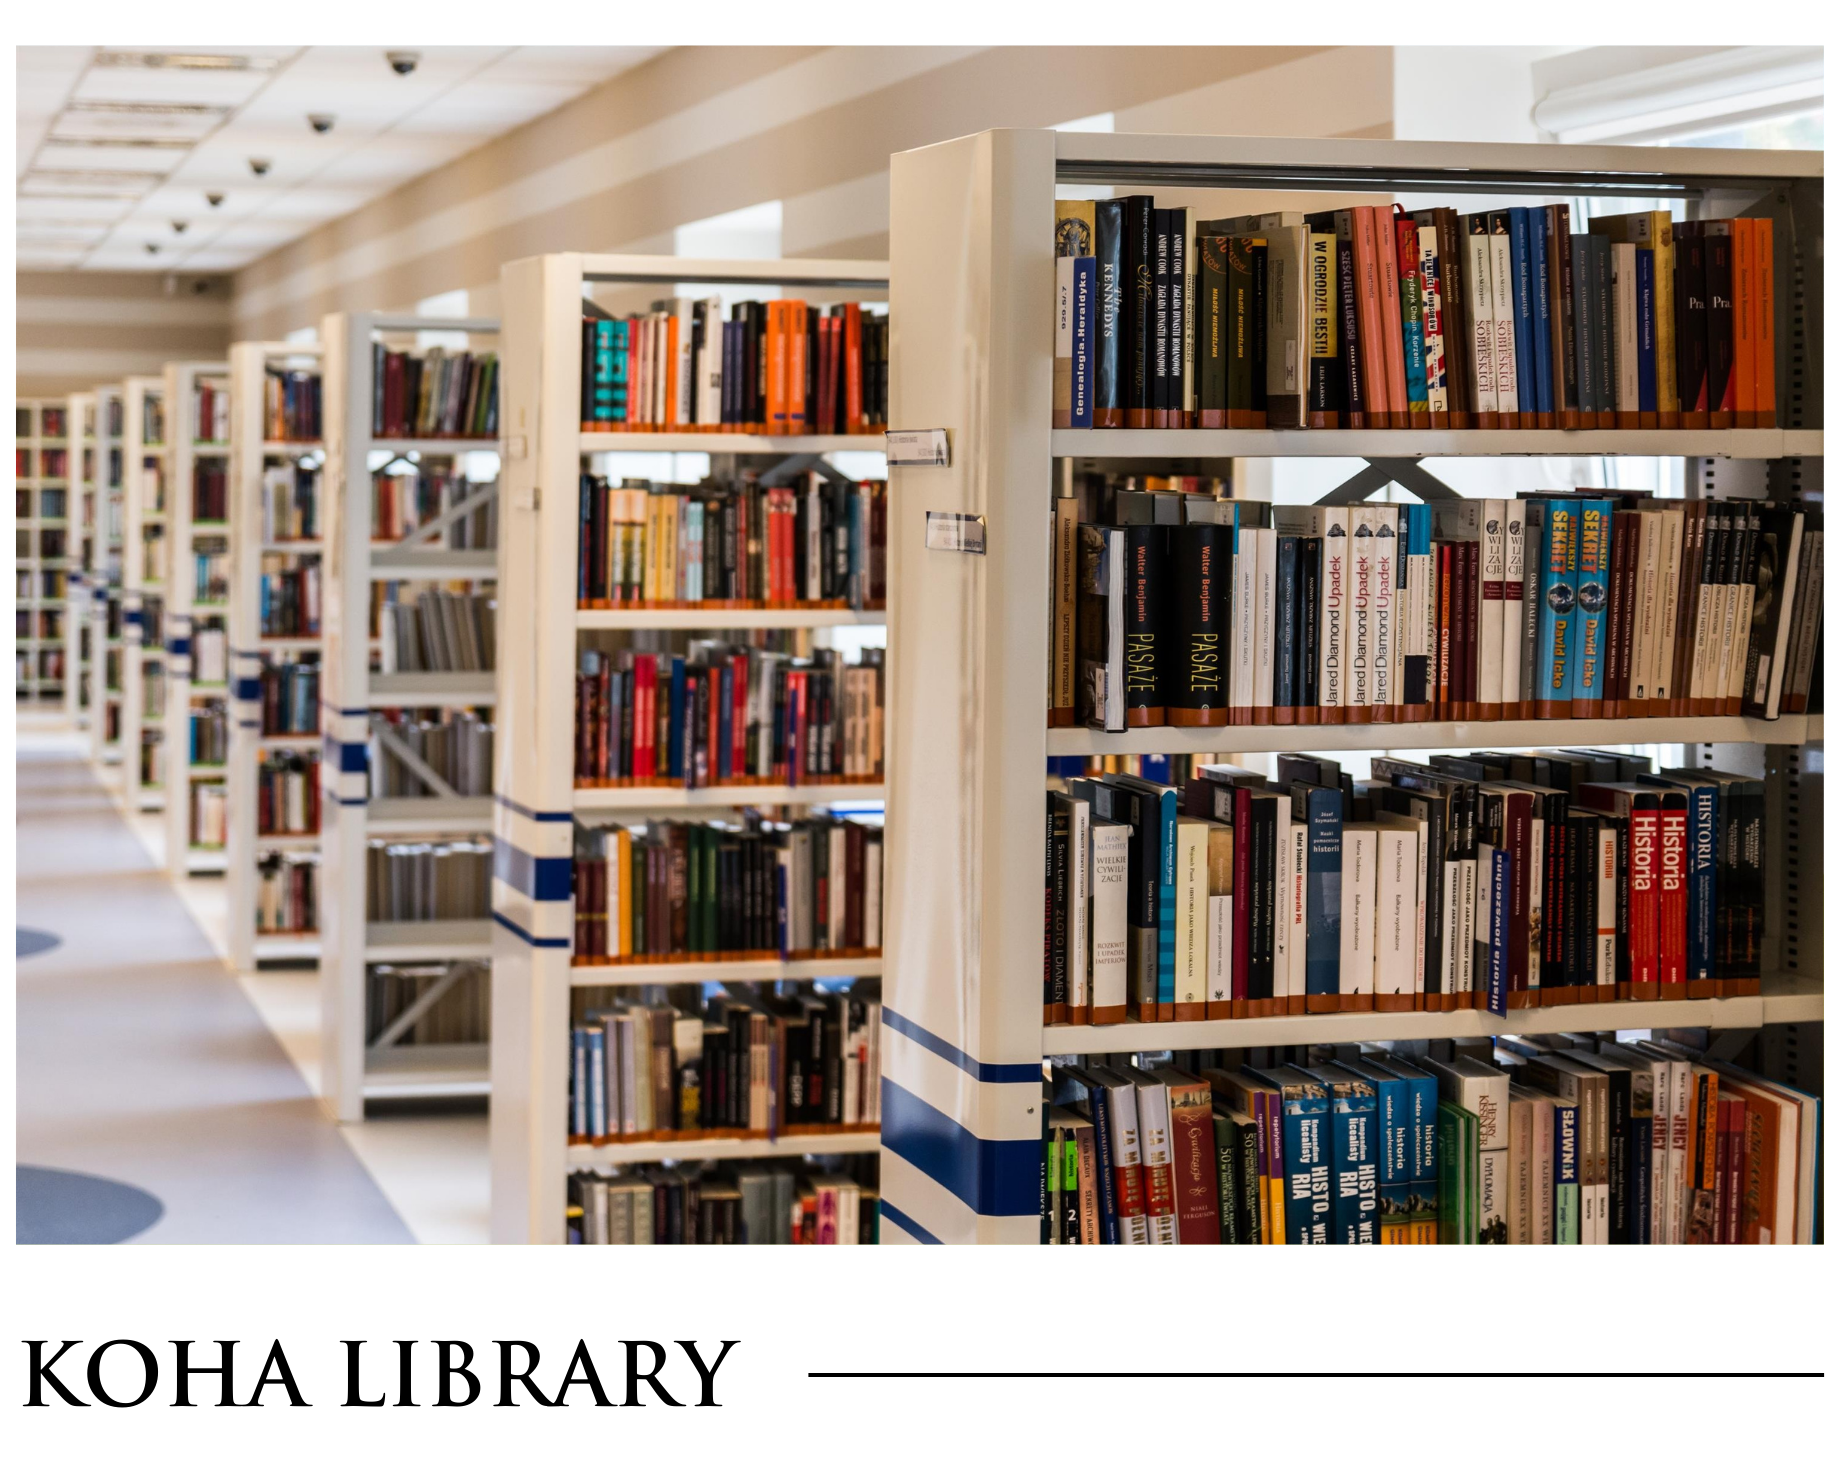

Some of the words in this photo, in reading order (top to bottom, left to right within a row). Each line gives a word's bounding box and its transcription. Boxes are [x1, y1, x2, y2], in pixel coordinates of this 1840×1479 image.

[1158, 234, 1166, 257] ANDREW
[1173, 234, 1182, 257] ANDREW
[1314, 241, 1328, 252] W
[1158, 259, 1166, 275] COOK
[1173, 259, 1182, 275] COOK
[1314, 256, 1328, 314] OGRODZIE
[1367, 263, 1375, 298] Stuartowie
[1386, 262, 1394, 298] Stuartowie
[1424, 250, 1434, 286] TAJEMNICE
[1445, 263, 1453, 303] Burbonowie
[1520, 262, 1528, 276] Ród
[1104, 263, 1113, 337] KENNEDYS
[1157, 285, 1166, 309] ZAGŁADA
[1173, 284, 1181, 309] ZAGŁADA
[1237, 288, 1245, 314] MIŁOŚĆ
[1427, 290, 1437, 330] WINDSORÓW
[1521, 278, 1529, 318] Bonapartych
[1540, 278, 1548, 319] Bonapartych
[1157, 311, 1167, 336] DYNASTII
[1172, 311, 1181, 336] DYNASTII
[1237, 316, 1245, 358] NIEMOŻLIWA
[1315, 318, 1328, 354] BESTII
[1407, 270, 1417, 303] Fryderyk
[1412, 335, 1421, 367] Korzenie
[1077, 272, 1086, 416] Genealogia.Heraldyka
[1156, 338, 1167, 377] ROMANOWÓW
[1172, 338, 1183, 376] ROMANOWÓW
[1476, 320, 1489, 393] SOBIESKICH
[1497, 320, 1510, 393] SOBIESKICH
[1138, 546, 1146, 575] Walter
[1202, 546, 1210, 575] Walter
[1551, 510, 1568, 575] SEKRET
[1567, 516, 1577, 570] NAJWIĘKSZY
[1582, 510, 1600, 573] SEKRET
[1598, 515, 1609, 570] NAJWIĘKSZY
[1328, 556, 1344, 608] Upadek
[1355, 556, 1371, 608] Upadek
[1377, 556, 1392, 608] Upadek
[1486, 565, 1502, 574] CJE
[1508, 565, 1523, 574] CJE
[1529, 573, 1537, 599] OSKAR
[1135, 579, 1146, 622] Benjamin
[1200, 579, 1211, 622] Benjamin
[1327, 610, 1341, 668] Diamond
[1354, 610, 1368, 668] Diamond
[1375, 610, 1390, 668] Diamond
[1528, 603, 1536, 638] HALECKI
[1554, 620, 1567, 656] David
[1585, 619, 1598, 655] David
[1644, 606, 1652, 635] wyobraźni
[1665, 608, 1673, 637] wyobraźni
[1128, 633, 1158, 692] PASAŻE
[1191, 633, 1222, 692] PASAŻE
[1441, 628, 1449, 686] CYWILIZACJE
[1553, 660, 1564, 688] Icke
[1583, 659, 1595, 687] Icke
[1326, 670, 1339, 706] Jared
[1353, 670, 1366, 706] Jared
[1373, 670, 1388, 705] Jared
[1296, 832, 1304, 847] Rafał
[1698, 794, 1712, 870] HISTORIA
[1604, 841, 1614, 879] HISTORIA
[1634, 817, 1657, 890] Historia
[1662, 816, 1685, 890] Historia
[1101, 875, 1123, 883] ZACJE
[1353, 894, 1361, 915] Bałkany
[1493, 855, 1503, 946] powszechna
[1146, 963, 1154, 982] MISES
[1492, 951, 1501, 1010] Historia
[1098, 1103, 1106, 1133] LEKSYKON
[1709, 1082, 1717, 1119] HISTORIA
[1359, 1117, 1367, 1161] Kompendium
[1479, 1095, 1489, 1146] KISSINGER
[1488, 1102, 1497, 1138] HENRY
[1653, 1115, 1669, 1151] JEŃCY
[1672, 1115, 1689, 1151] JEŃCY
[1100, 1134, 1108, 1166] POLITYKÓW
[1188, 1127, 1203, 1181] Cywilizacja
[1300, 1120, 1311, 1163] licealisty
[1347, 1118, 1359, 1161] licealisty
[1386, 1127, 1394, 1180] społeczeństwie
[1396, 1127, 1405, 1169] historia
[1424, 1125, 1434, 1166] historia
[1705, 1122, 1715, 1184] POWSZECHNA
[1220, 1148, 1232, 1162] 50
[1226, 1164, 1234, 1210] NAJWIĘKSZYCH
[1244, 1133, 1254, 1147] 50
[1249, 1148, 1257, 1195] NAJWIĘKSZYCH
[1105, 1191, 1113, 1214] CZASÓW
[1292, 1173, 1311, 1200] RIA
[1312, 1166, 1329, 1213] HISTO
[1340, 1171, 1358, 1198] RIA
[1359, 1164, 1376, 1211] HISTO
[1484, 1157, 1493, 1213] DYPLOMACJA
[1068, 1210, 1076, 1221] 2
[1274, 1202, 1282, 1233] HISTORIA
